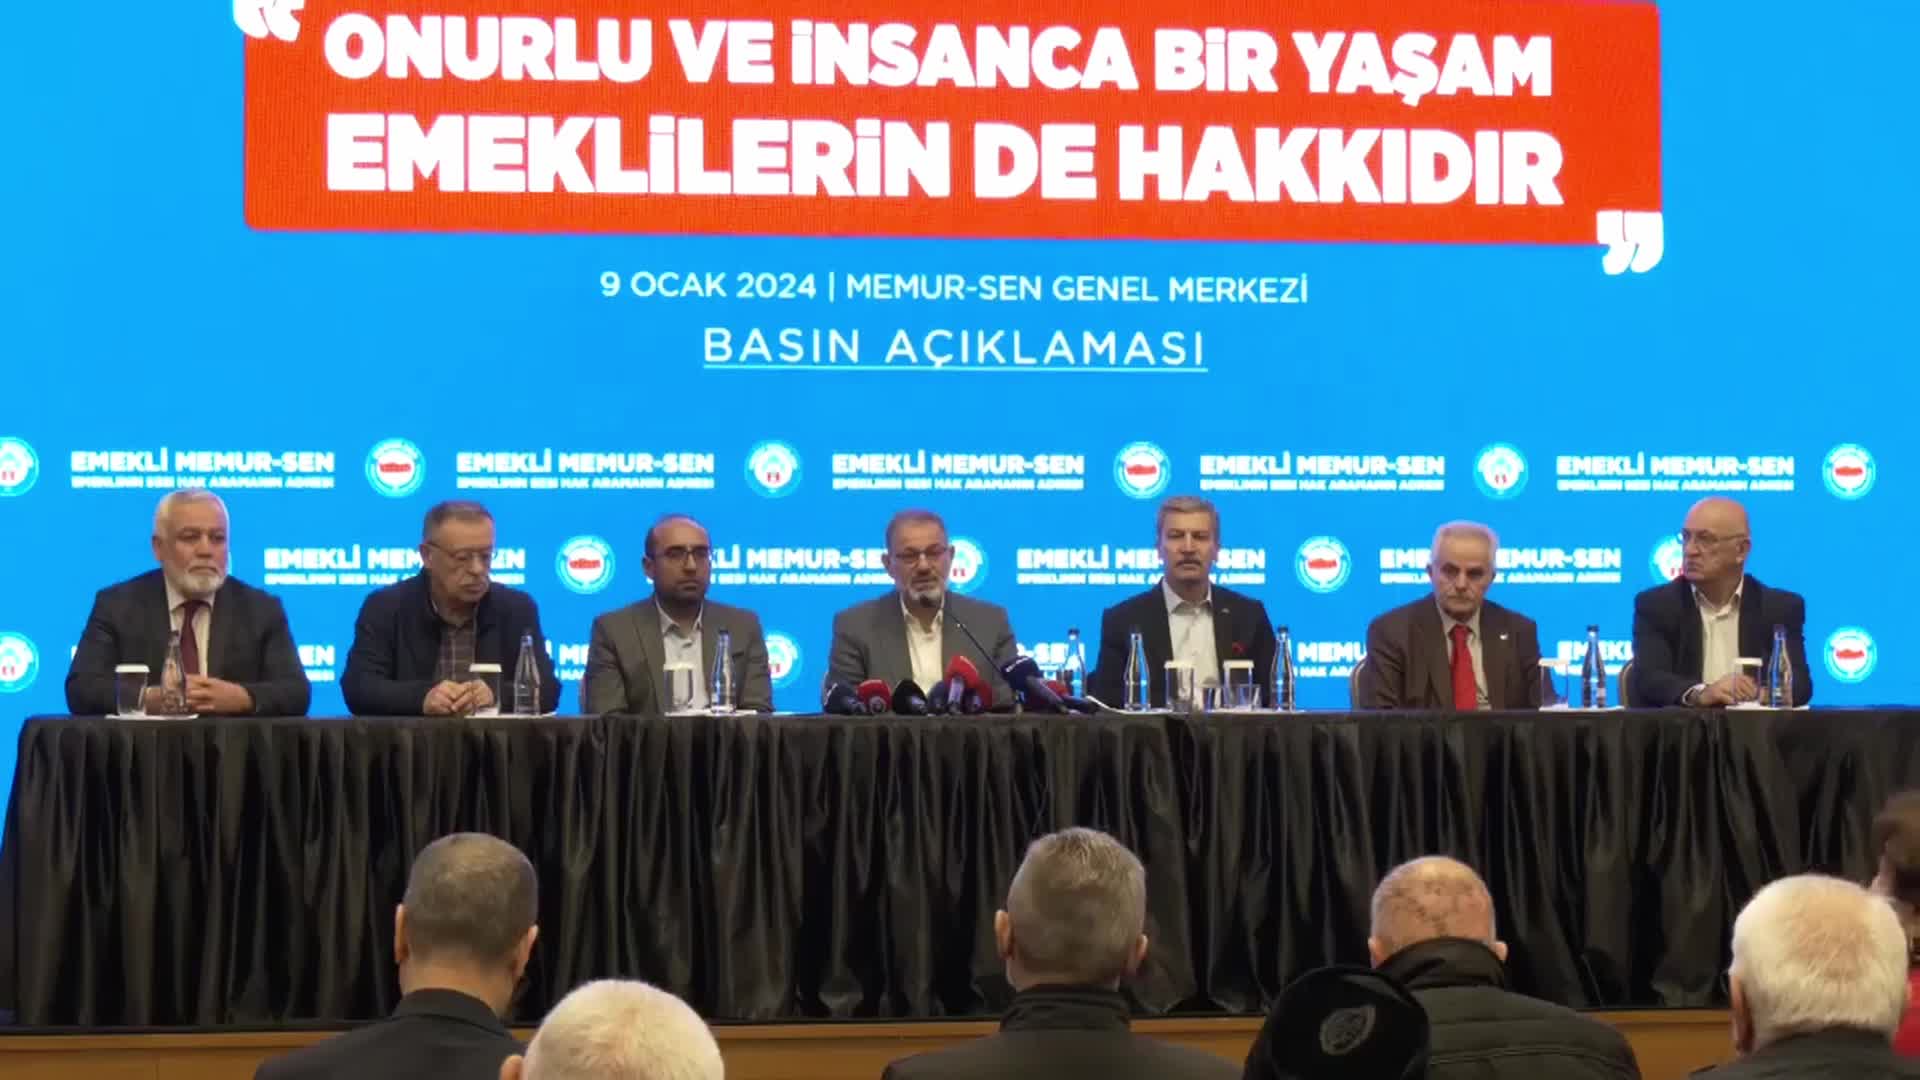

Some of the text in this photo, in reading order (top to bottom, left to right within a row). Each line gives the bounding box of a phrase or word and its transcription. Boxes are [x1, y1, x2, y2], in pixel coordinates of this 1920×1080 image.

[324, 13, 1552, 108] ONURLU VE İNSANCA BİR YAŞAM
[327, 113, 1564, 206] EMEKLİLERİN DE HAKKIDIR
[600, 271, 621, 298] 9
[631, 271, 727, 298] OCAK
[737, 272, 817, 299] 2024
[847, 274, 1042, 301] MEMUR-SEN
[1052, 275, 1158, 302] GENEL
[1169, 272, 1309, 304] MERKEZİ
[704, 327, 1203, 368] BASIN AÇIKLAMASI
[71, 447, 335, 473] EMEKLİ MEMUR-SEN
[456, 448, 715, 474] EMEKLİ MEMUR-SEN
[832, 449, 1085, 475] EMEKLİ MEMUR-SEN
[1200, 451, 1445, 476] EMEKLİ MEMUR-SEN
[1556, 452, 1795, 476] EMEKLİ MEMUR-SEN
[264, 544, 361, 570] EMEKLİ
[746, 548, 888, 570] MEMUR-SE
[1017, 545, 1110, 570] EMEKLİ
[1496, 548, 1621, 569] EMUR-SEN
